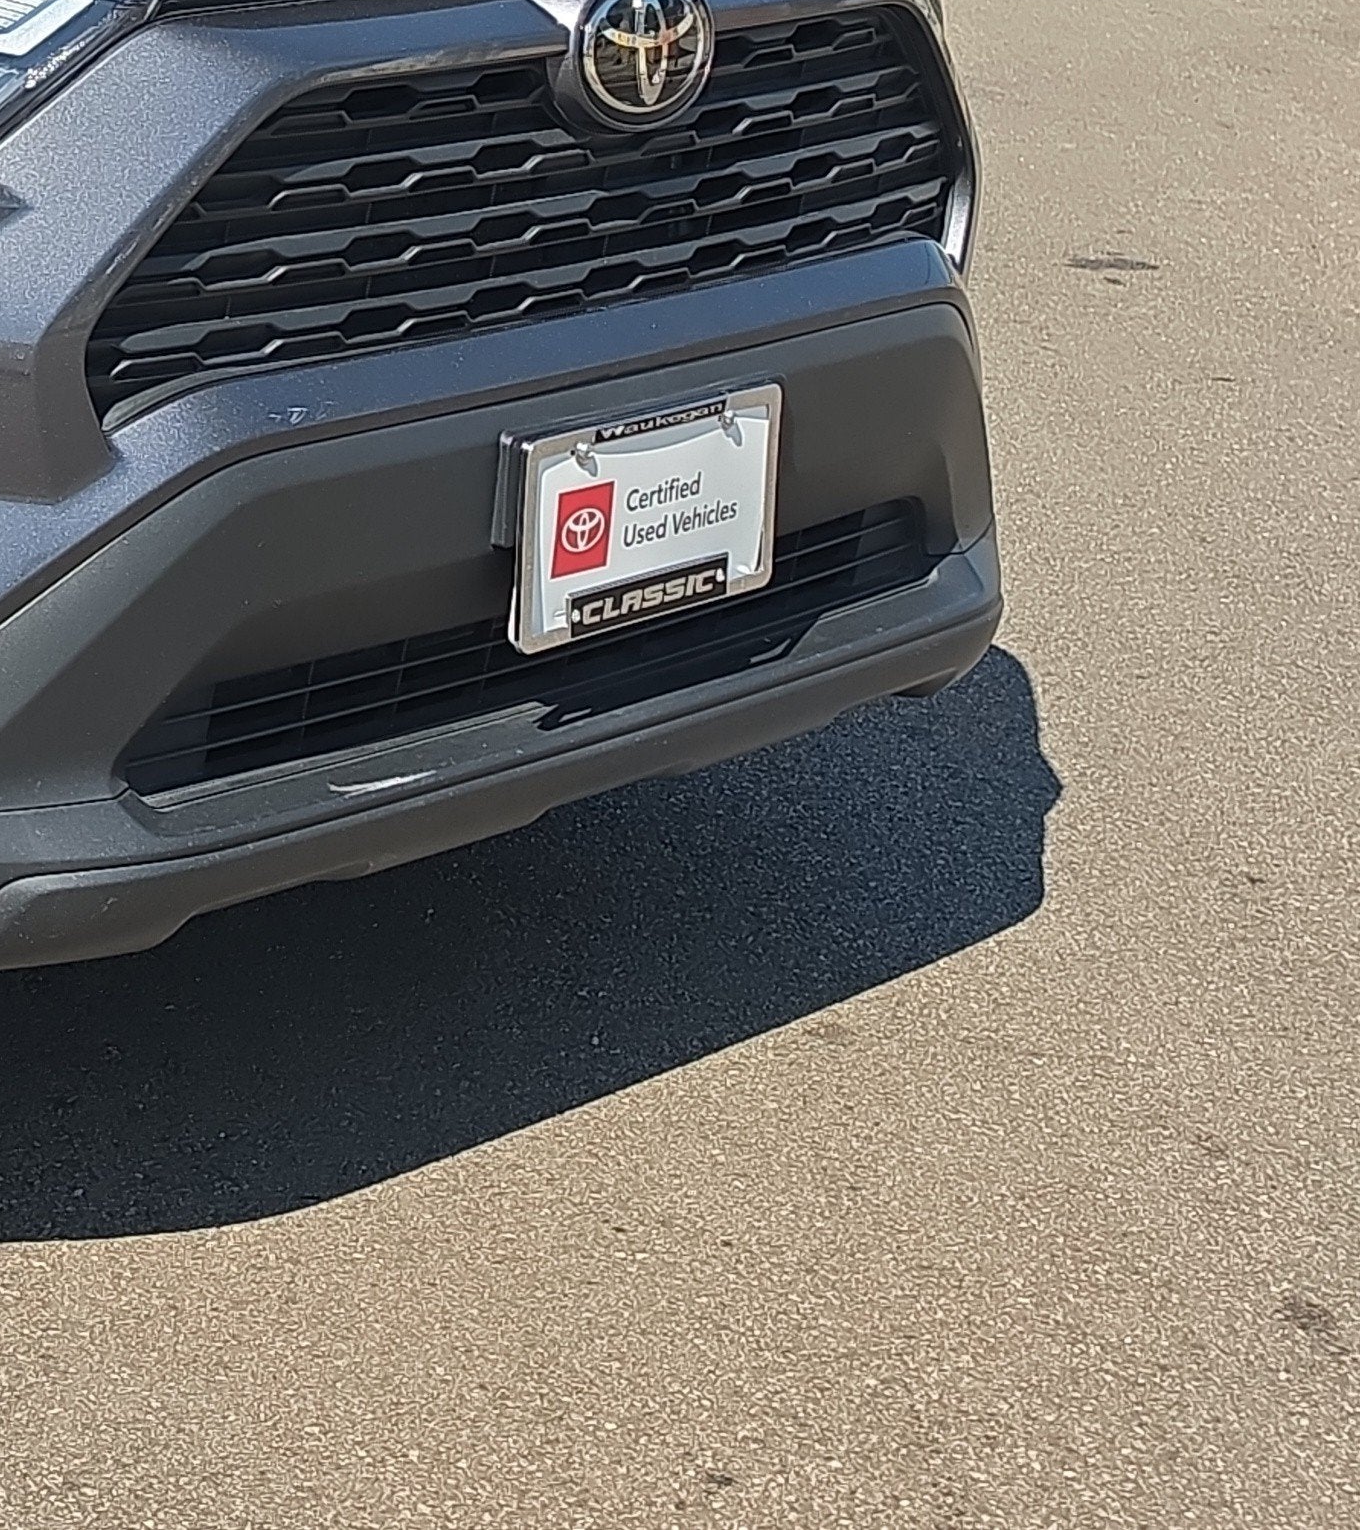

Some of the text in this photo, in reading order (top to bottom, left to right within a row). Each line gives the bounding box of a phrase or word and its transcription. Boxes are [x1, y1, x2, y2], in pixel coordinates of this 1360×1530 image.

[625, 470, 702, 513] Certified
[622, 498, 739, 548] Used Vehicles
[581, 568, 717, 626] CLASSIC
